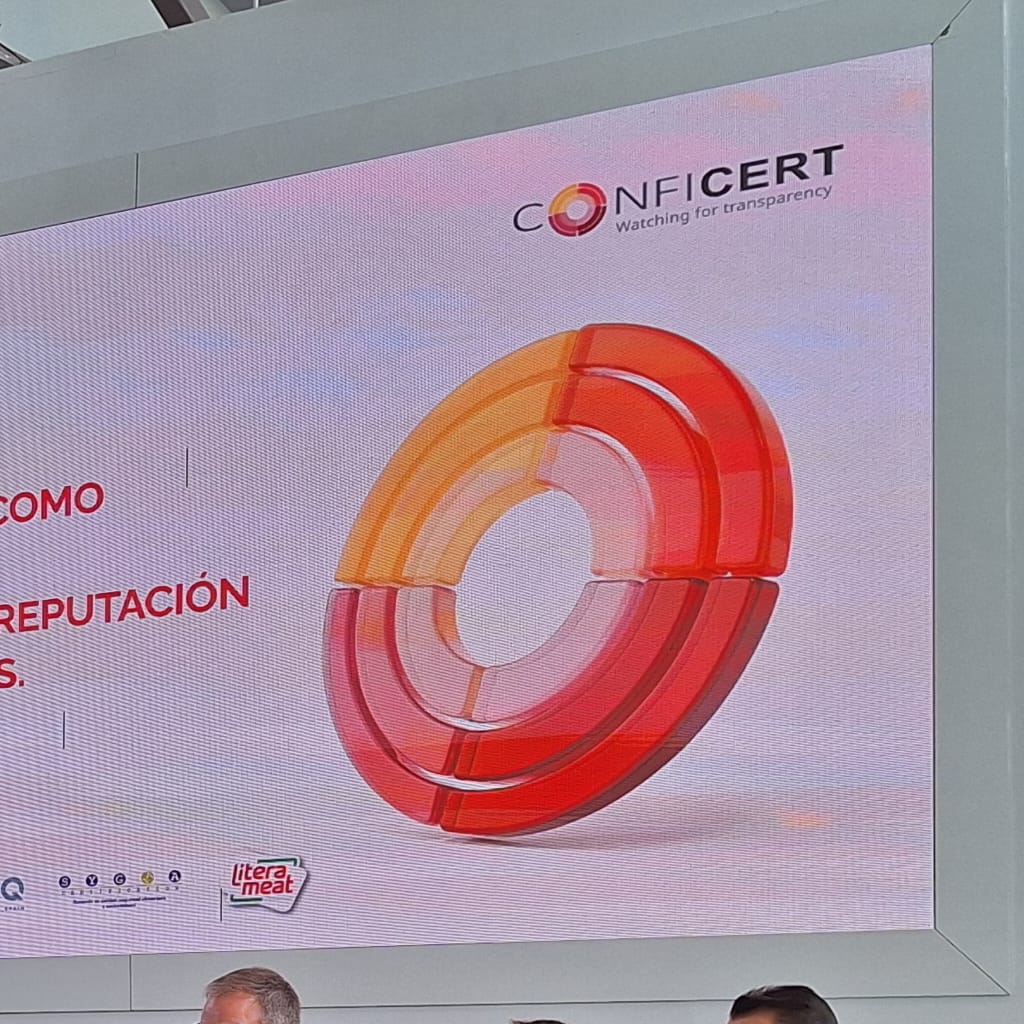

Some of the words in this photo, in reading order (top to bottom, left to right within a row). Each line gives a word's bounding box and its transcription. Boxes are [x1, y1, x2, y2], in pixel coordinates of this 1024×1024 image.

[513, 144, 844, 237] CONFICERT
[616, 211, 690, 233] Watching
[695, 204, 719, 219] for
[723, 184, 833, 213] transparency
[241, 875, 294, 897] meat
